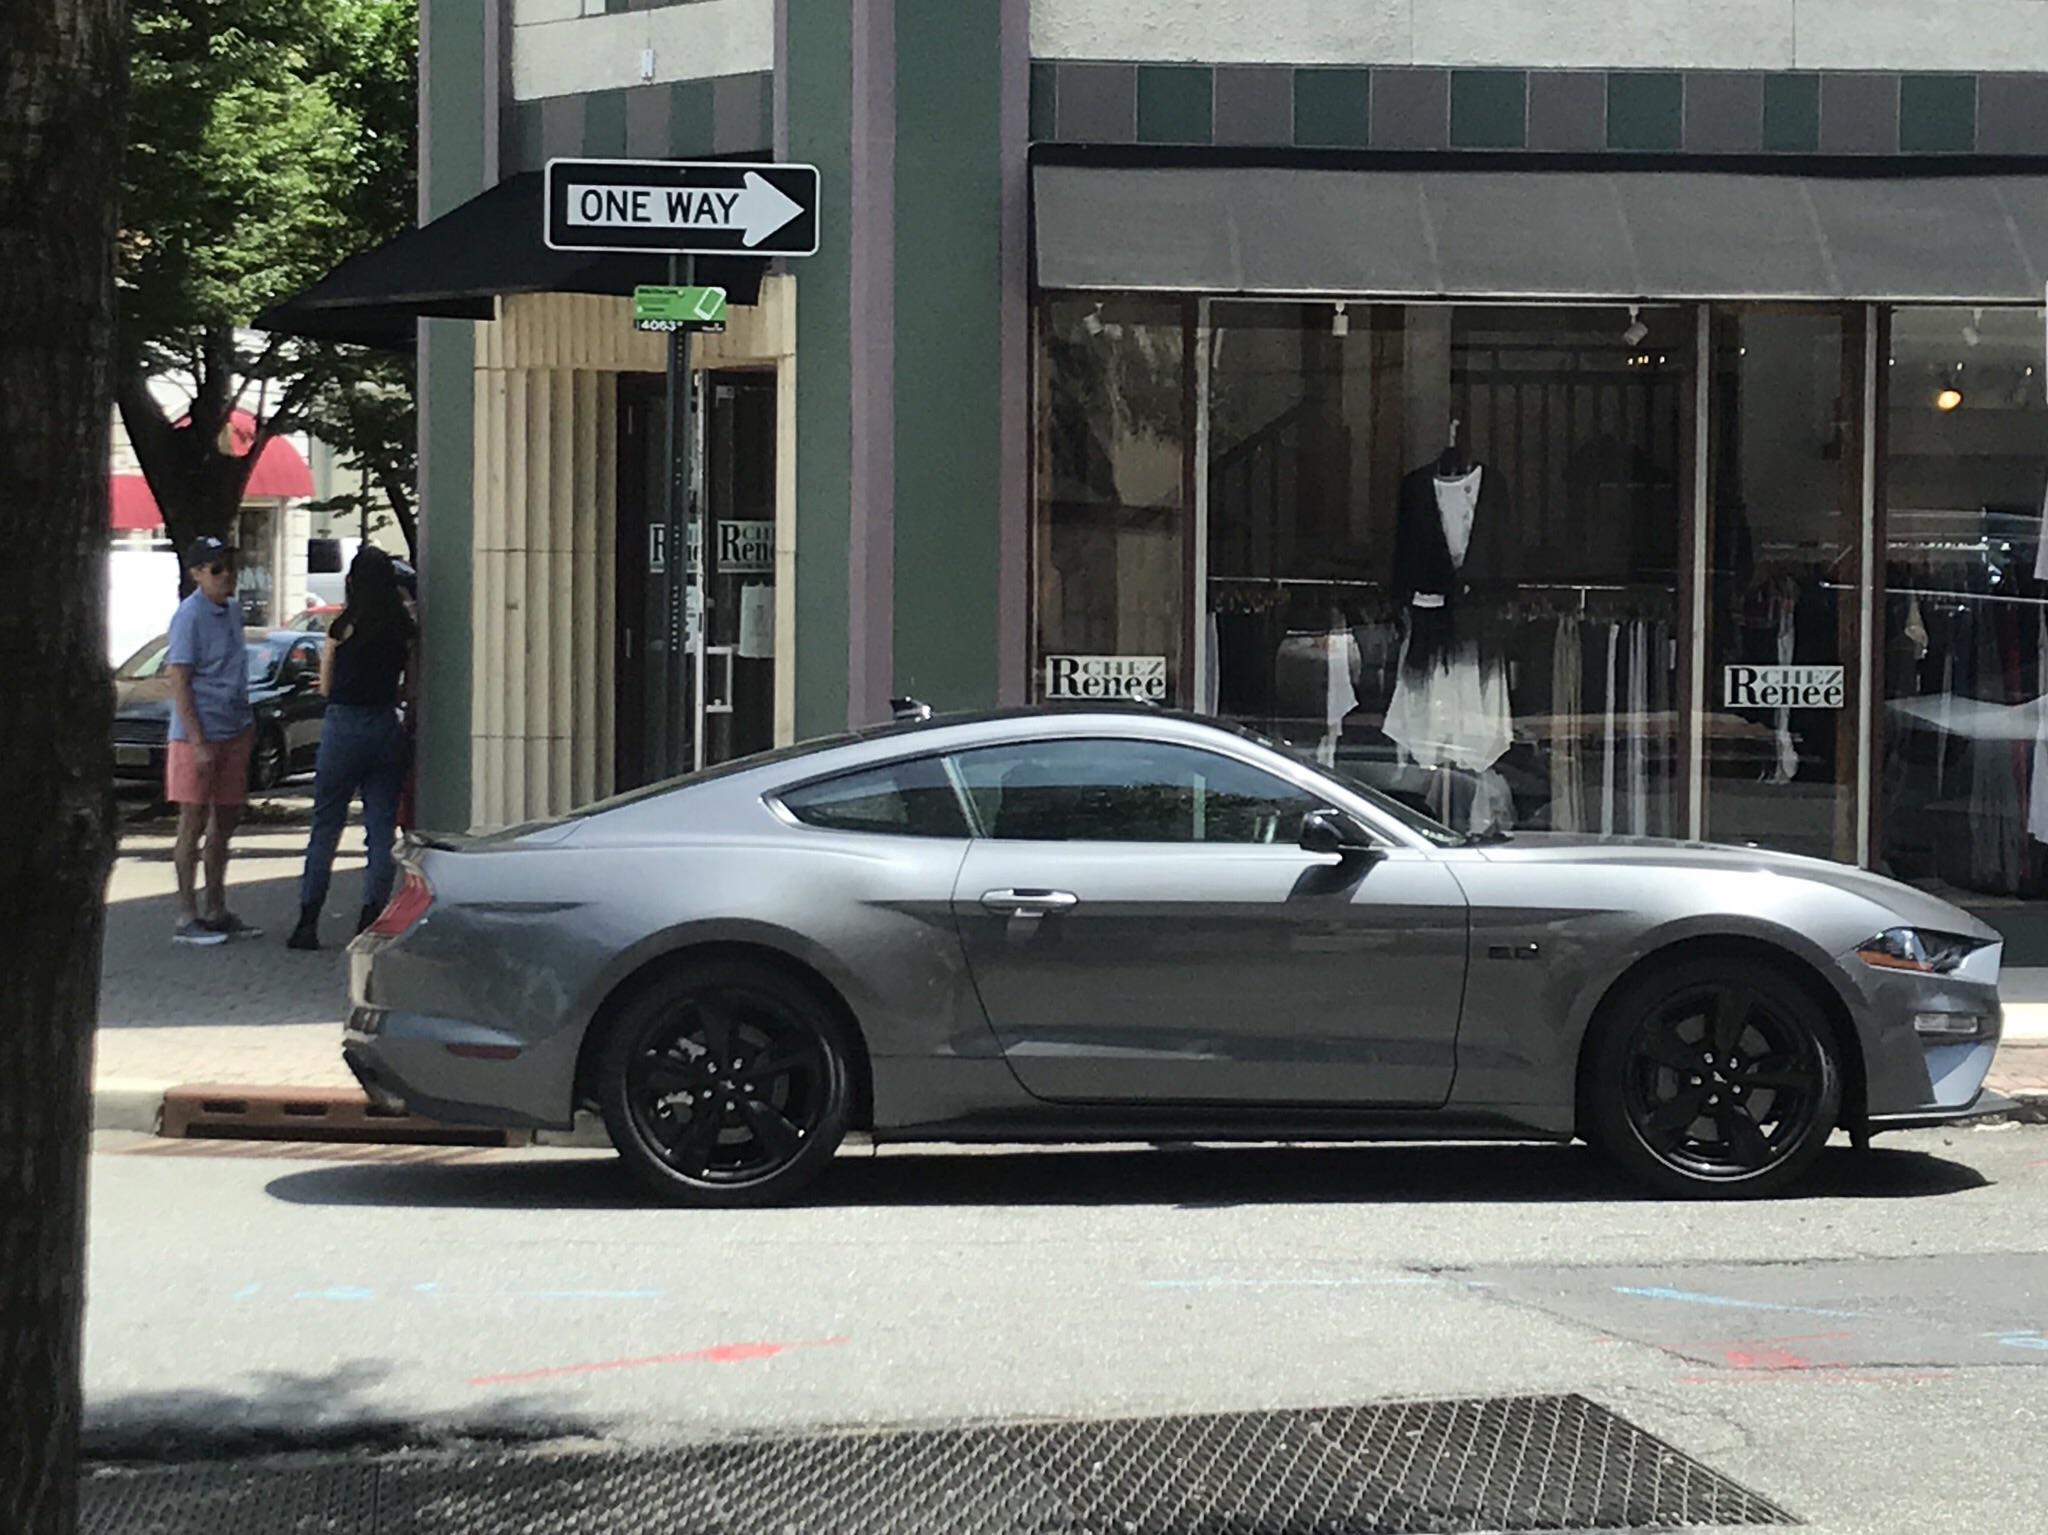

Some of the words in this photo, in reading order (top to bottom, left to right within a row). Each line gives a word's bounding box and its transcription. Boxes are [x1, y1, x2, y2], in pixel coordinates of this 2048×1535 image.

[581, 189, 651, 222] ONE
[666, 191, 739, 224] WAY
[1082, 661, 1164, 676] CHEZ
[1760, 670, 1842, 685] CHEZ
